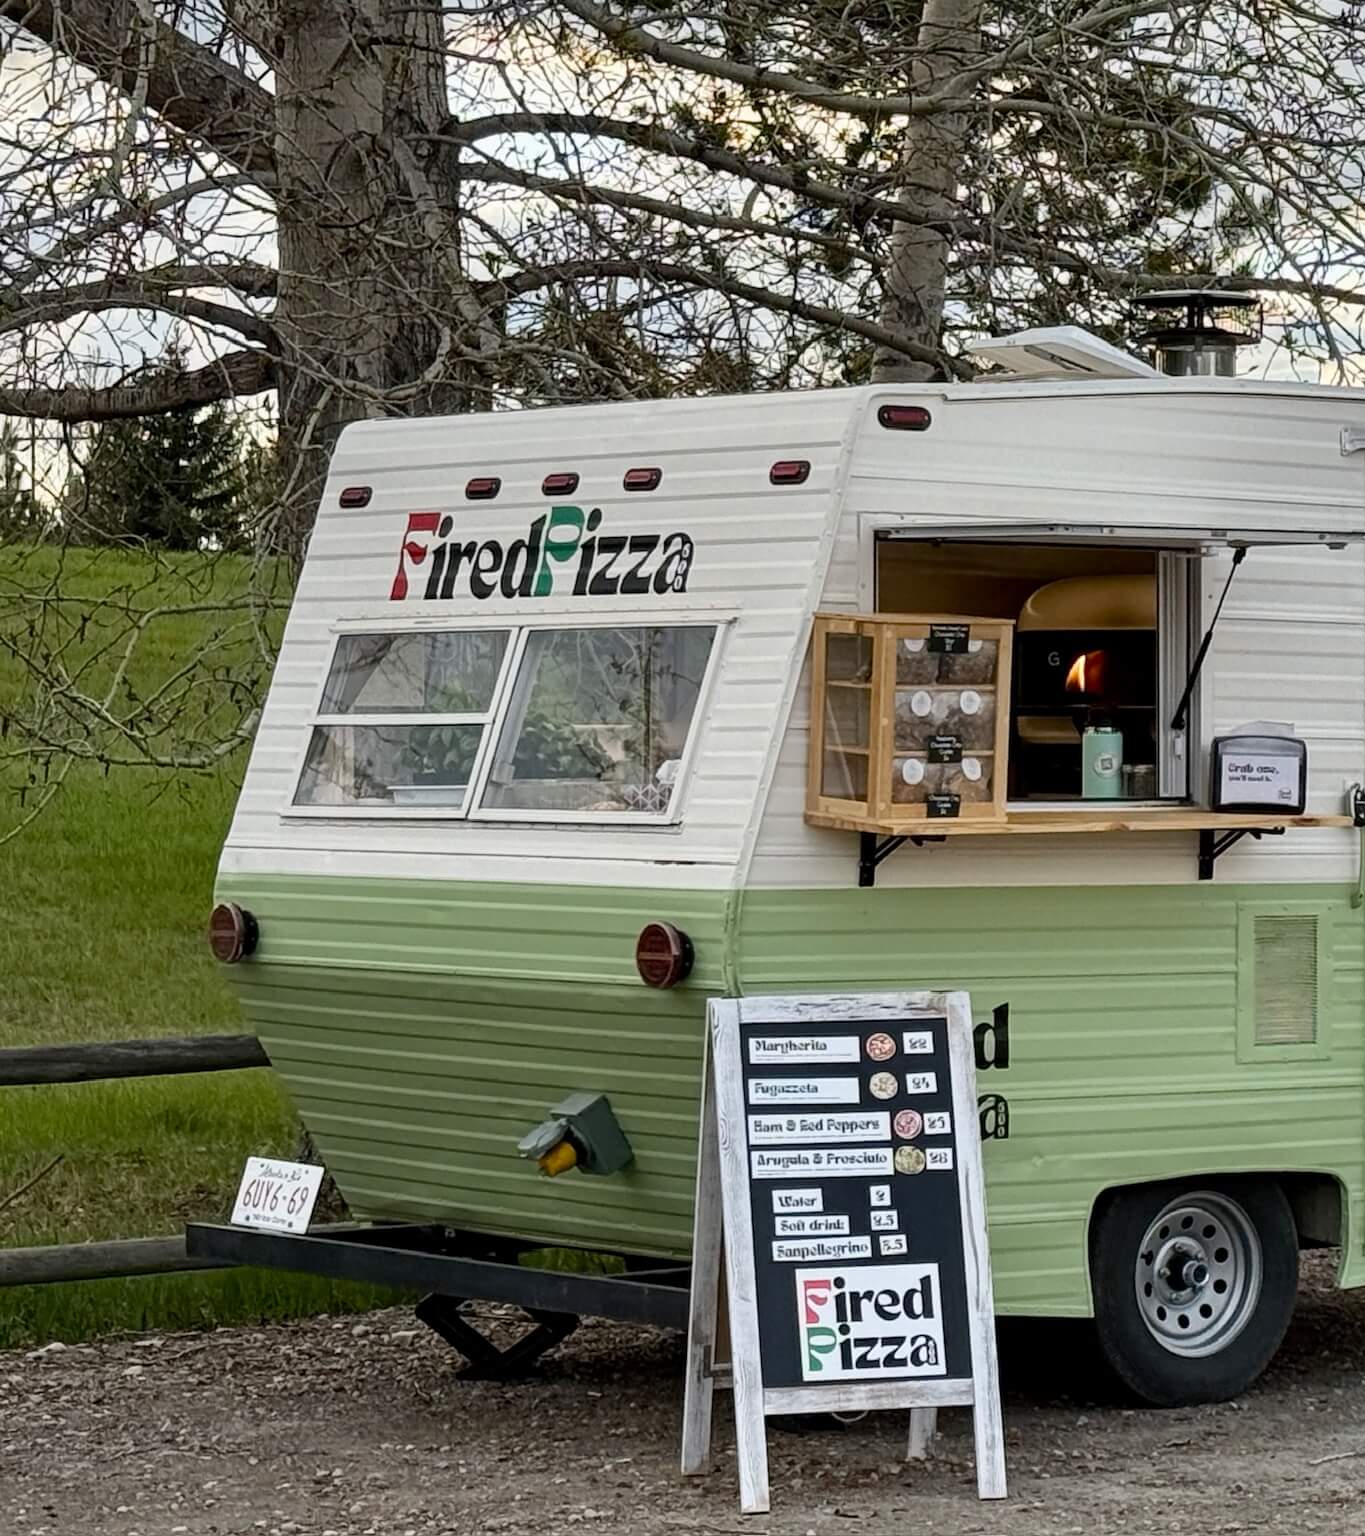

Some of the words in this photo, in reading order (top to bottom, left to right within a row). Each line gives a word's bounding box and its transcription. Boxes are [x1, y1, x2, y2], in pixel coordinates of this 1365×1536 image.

[754, 1039, 828, 1055] Margherita
[908, 1037, 928, 1050] 22
[754, 1081, 819, 1097] Fugazzeta
[912, 1076, 930, 1090] 24
[754, 1119, 783, 1133] Ham
[786, 1119, 797, 1132] &
[799, 1118, 824, 1132] Red
[826, 1117, 881, 1134] Peppers
[927, 1115, 946, 1129] 25
[757, 1153, 810, 1169] Arugula
[813, 1152, 823, 1165] &
[778, 1195, 818, 1208] Water
[875, 1189, 885, 1202] 2
[780, 1219, 805, 1232] Soft
[808, 1218, 845, 1231] drink
[872, 1214, 895, 1227] 2.5
[776, 1240, 869, 1260] Sanpellegrino
[803, 1274, 935, 1324] Fired
[806, 1323, 939, 1371] Pizza
